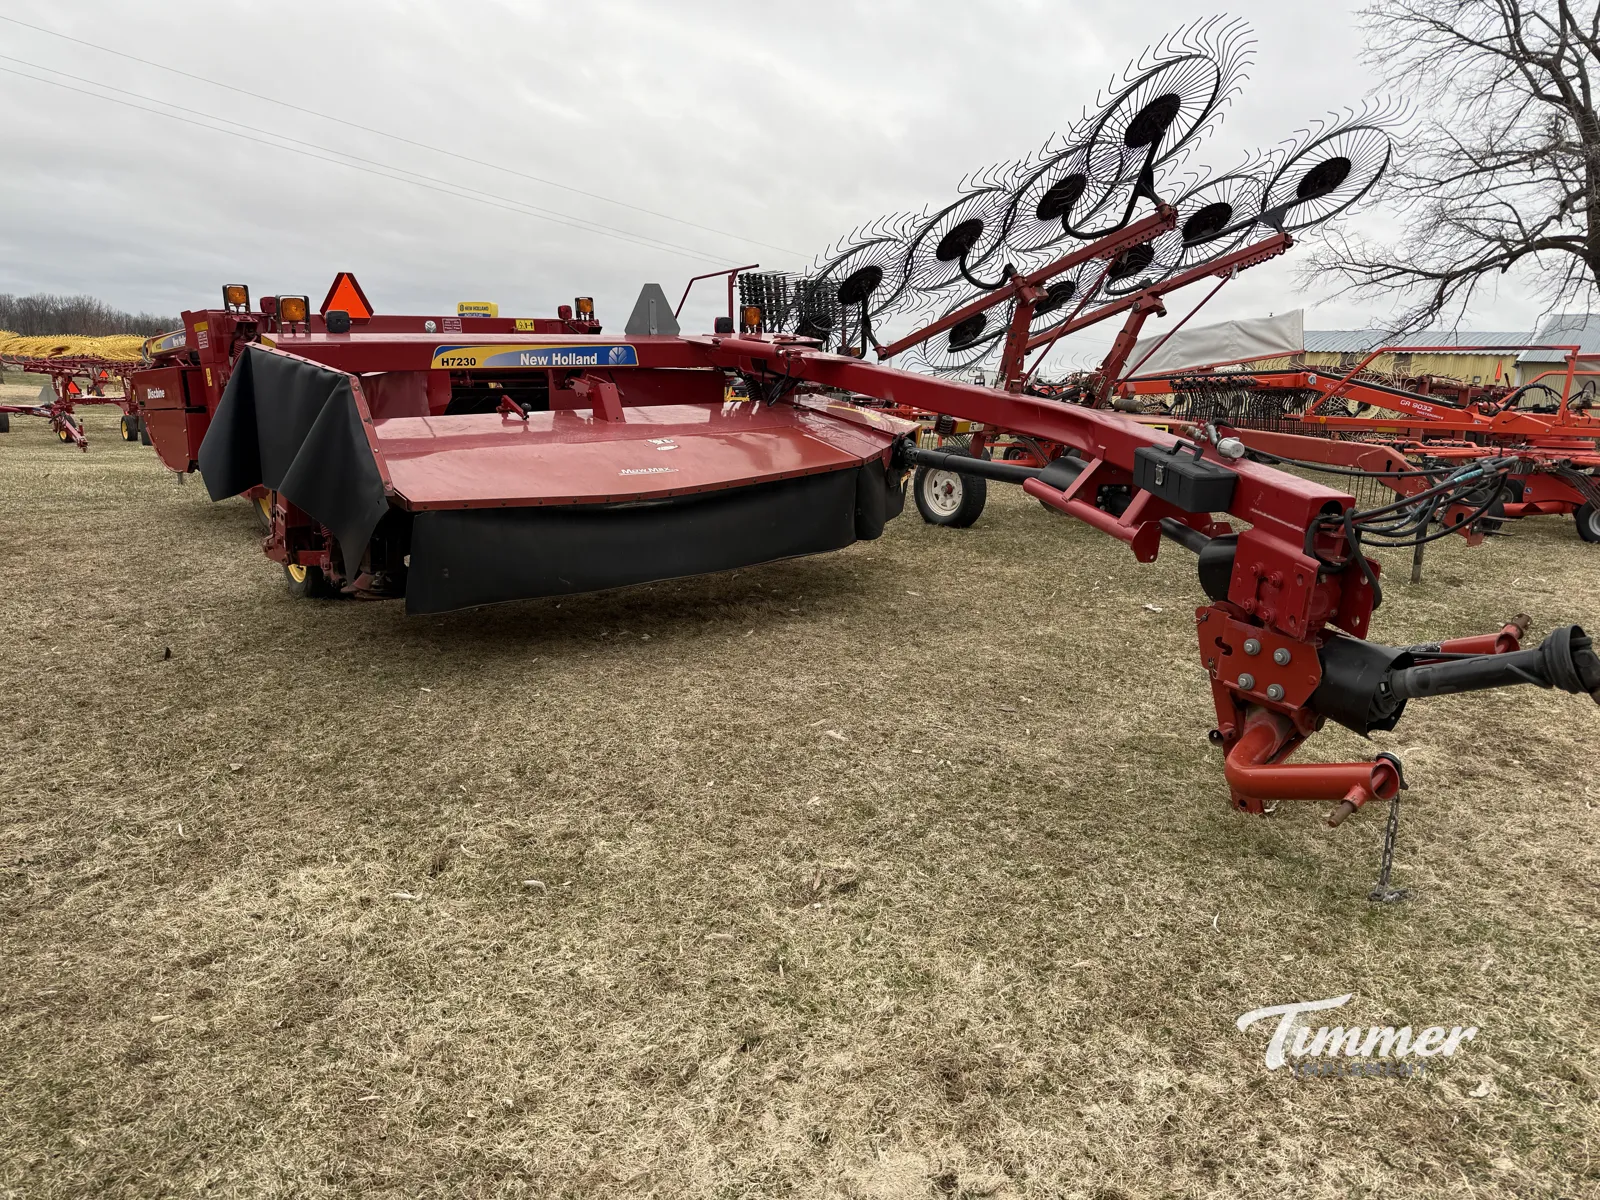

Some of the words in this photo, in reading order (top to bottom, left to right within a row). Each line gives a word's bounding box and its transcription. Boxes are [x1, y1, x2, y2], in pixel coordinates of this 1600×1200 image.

[441, 357, 476, 366] H7230
[520, 353, 548, 366] New
[552, 353, 598, 365] Holland
[147, 387, 165, 399] Discbine
[1412, 402, 1433, 412] 9032
